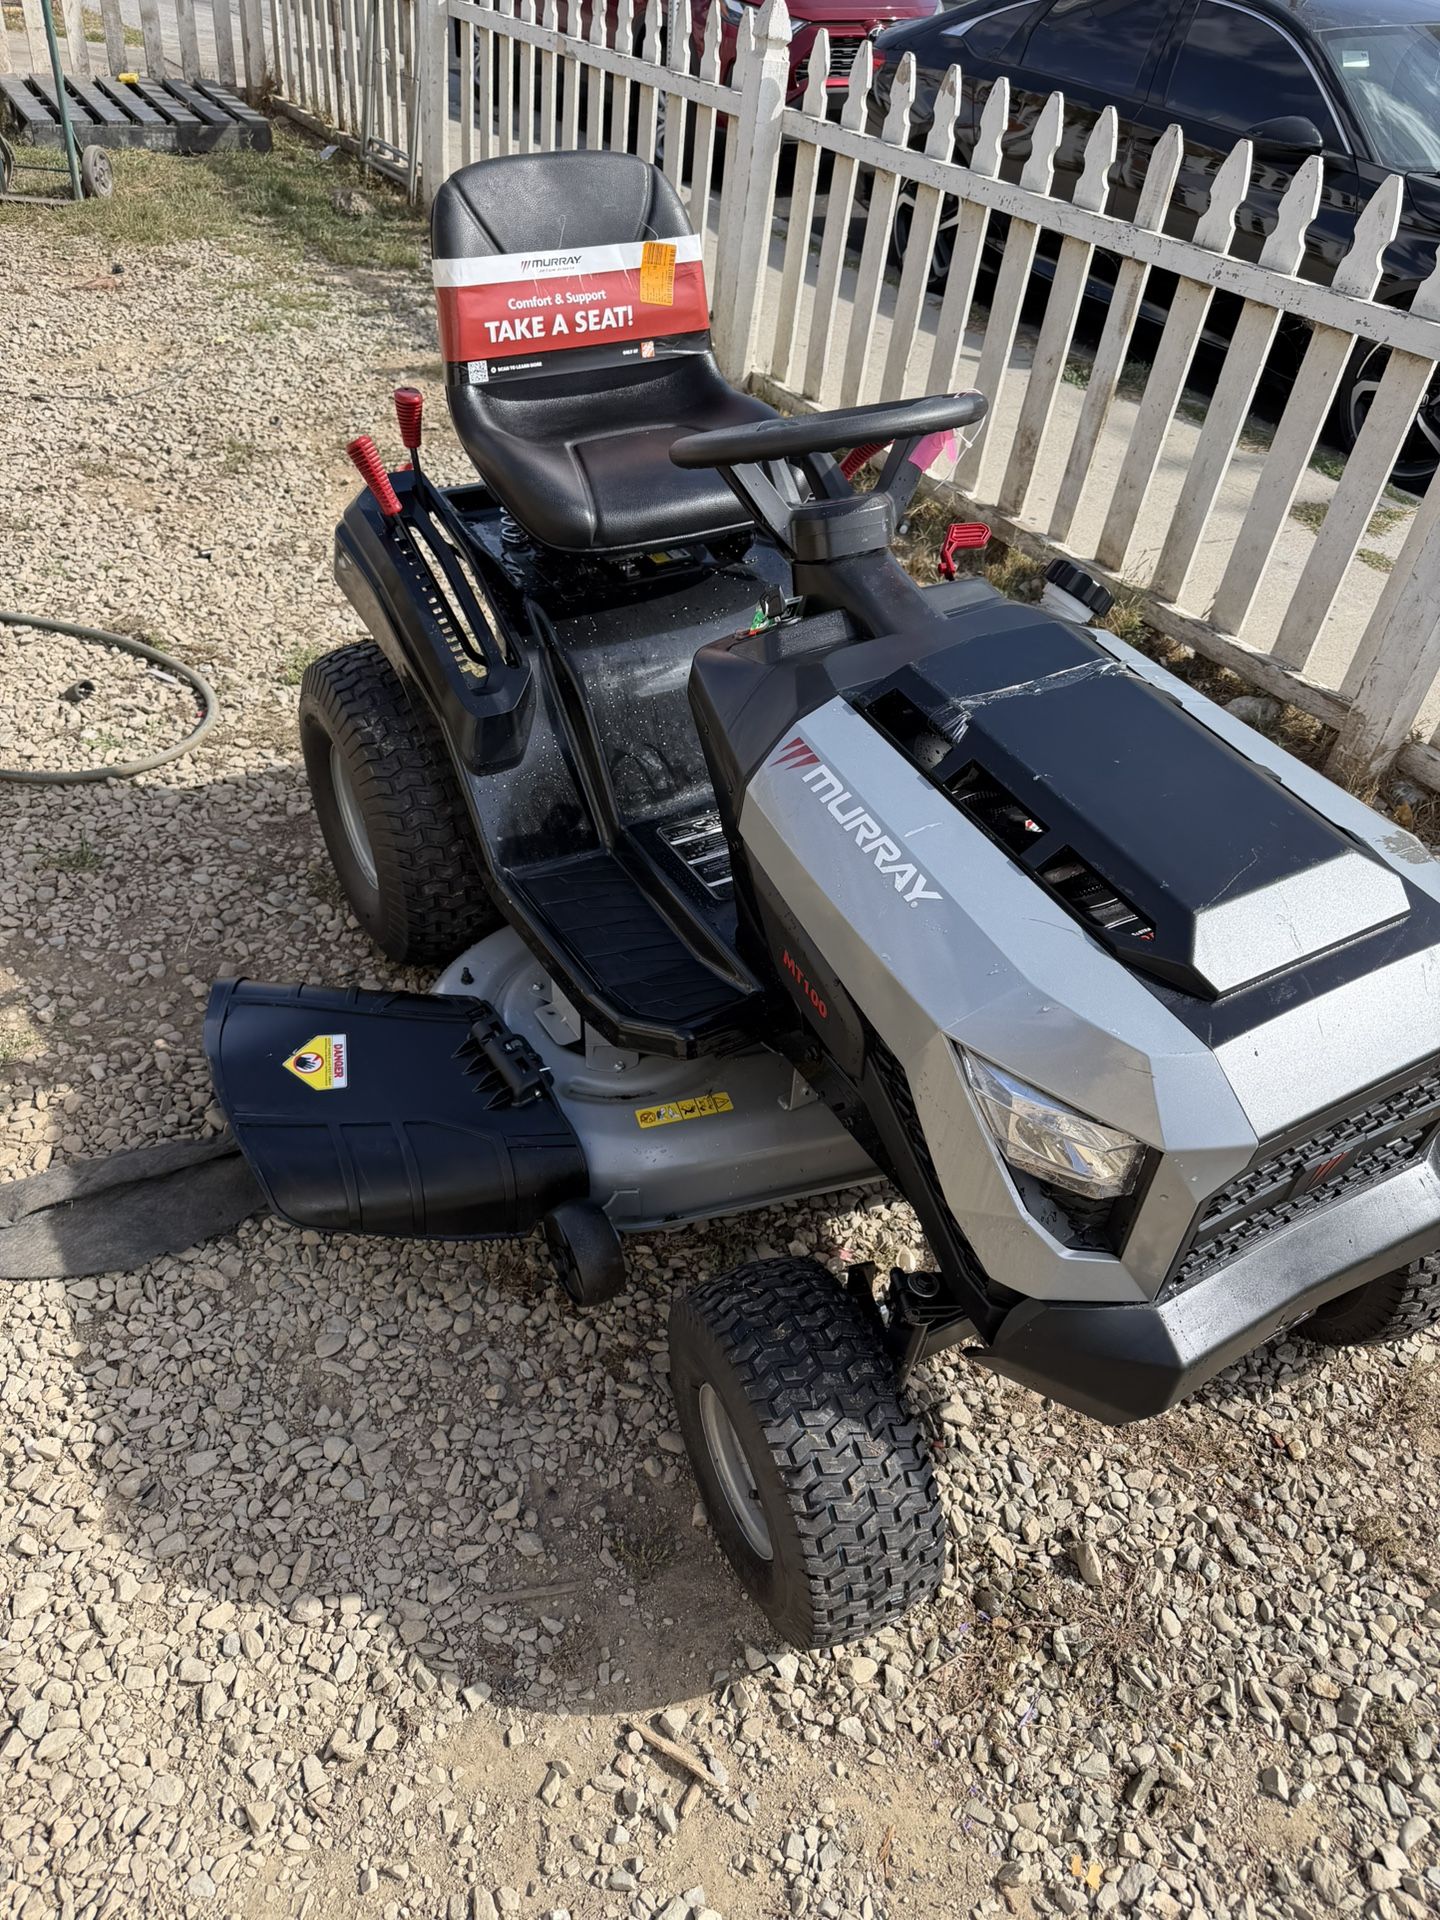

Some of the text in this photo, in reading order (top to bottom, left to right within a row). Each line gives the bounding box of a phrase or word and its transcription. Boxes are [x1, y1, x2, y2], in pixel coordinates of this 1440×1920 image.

[532, 256, 582, 268] MURRAY
[508, 290, 606, 310] Comfort & Support
[484, 305, 633, 343] TAKE A SEAT!
[802, 764, 944, 903] MURRAY
[783, 950, 828, 1019] MT100
[333, 1043, 344, 1078] DANGER
